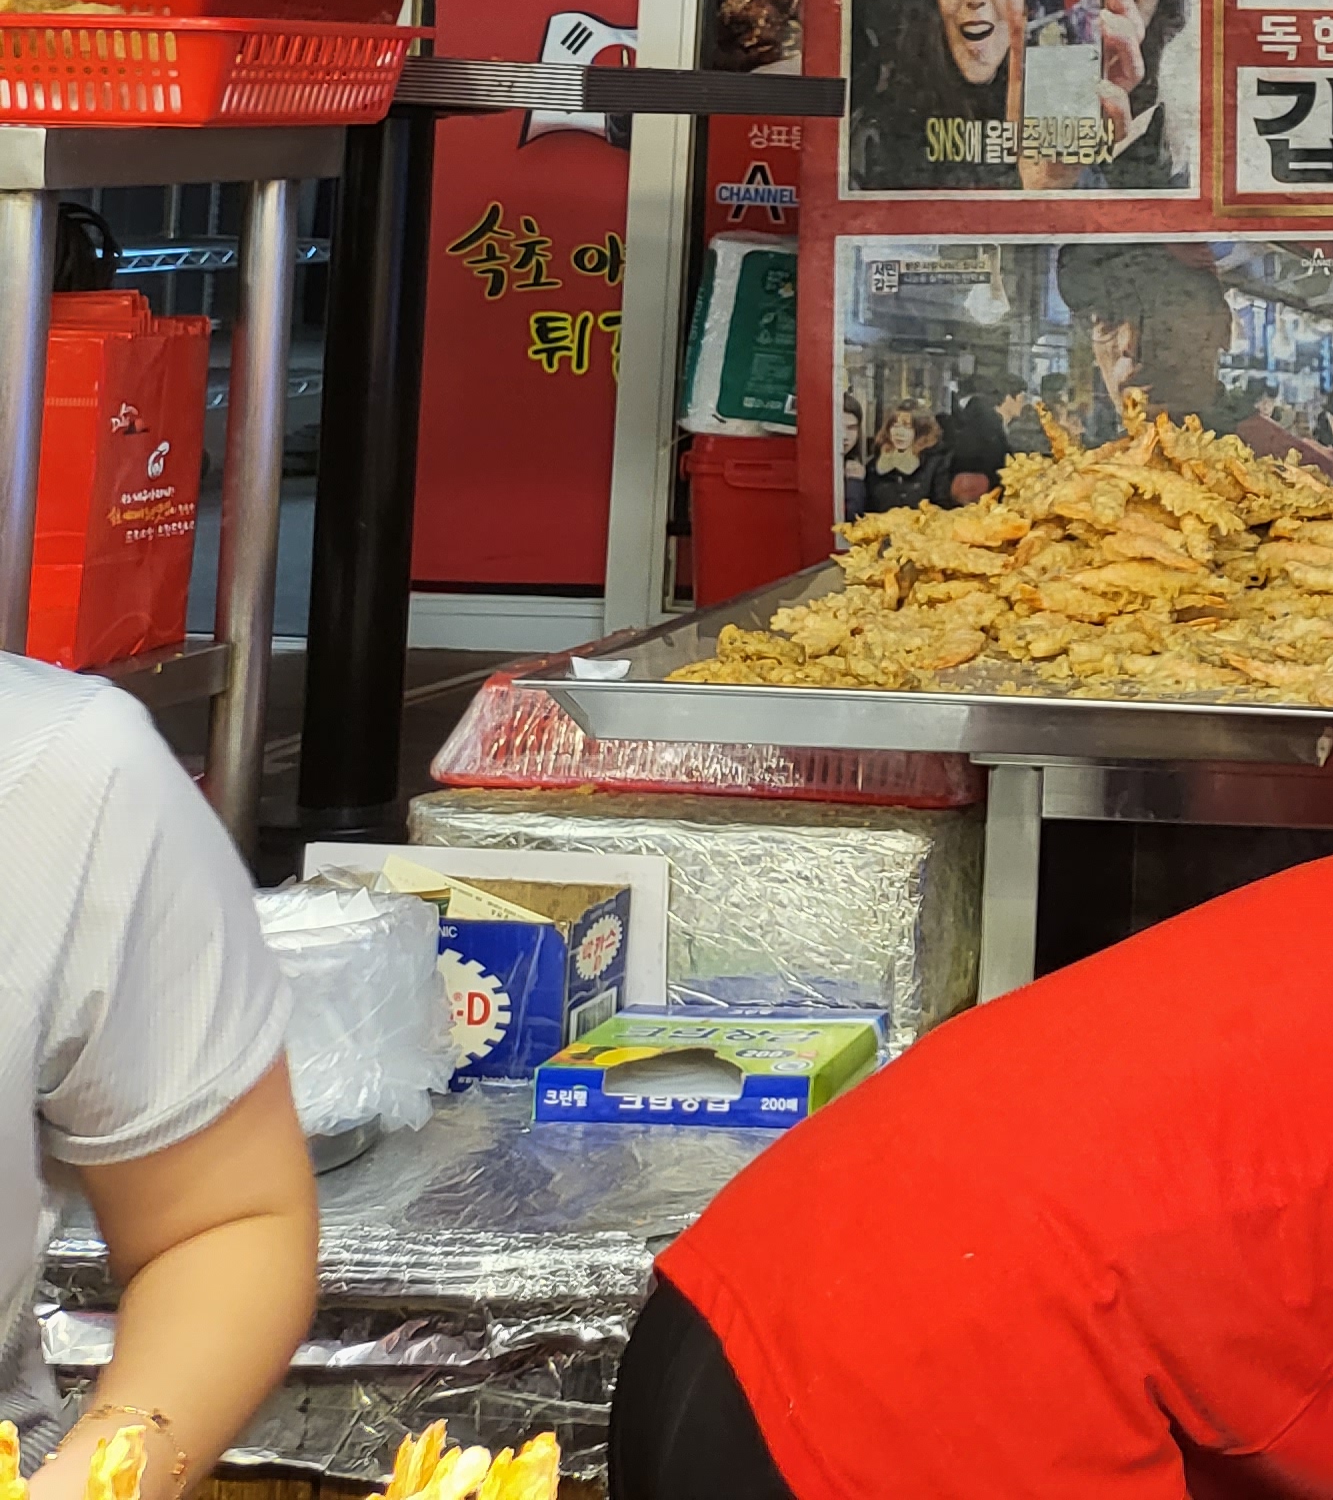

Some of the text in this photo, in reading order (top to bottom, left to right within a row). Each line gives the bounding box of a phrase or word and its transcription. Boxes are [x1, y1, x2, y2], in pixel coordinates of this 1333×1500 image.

[927, 117, 982, 164] SNS에
[986, 120, 1018, 164] 올린
[719, 185, 798, 204] CHANNEL
[447, 202, 562, 299] 속초
